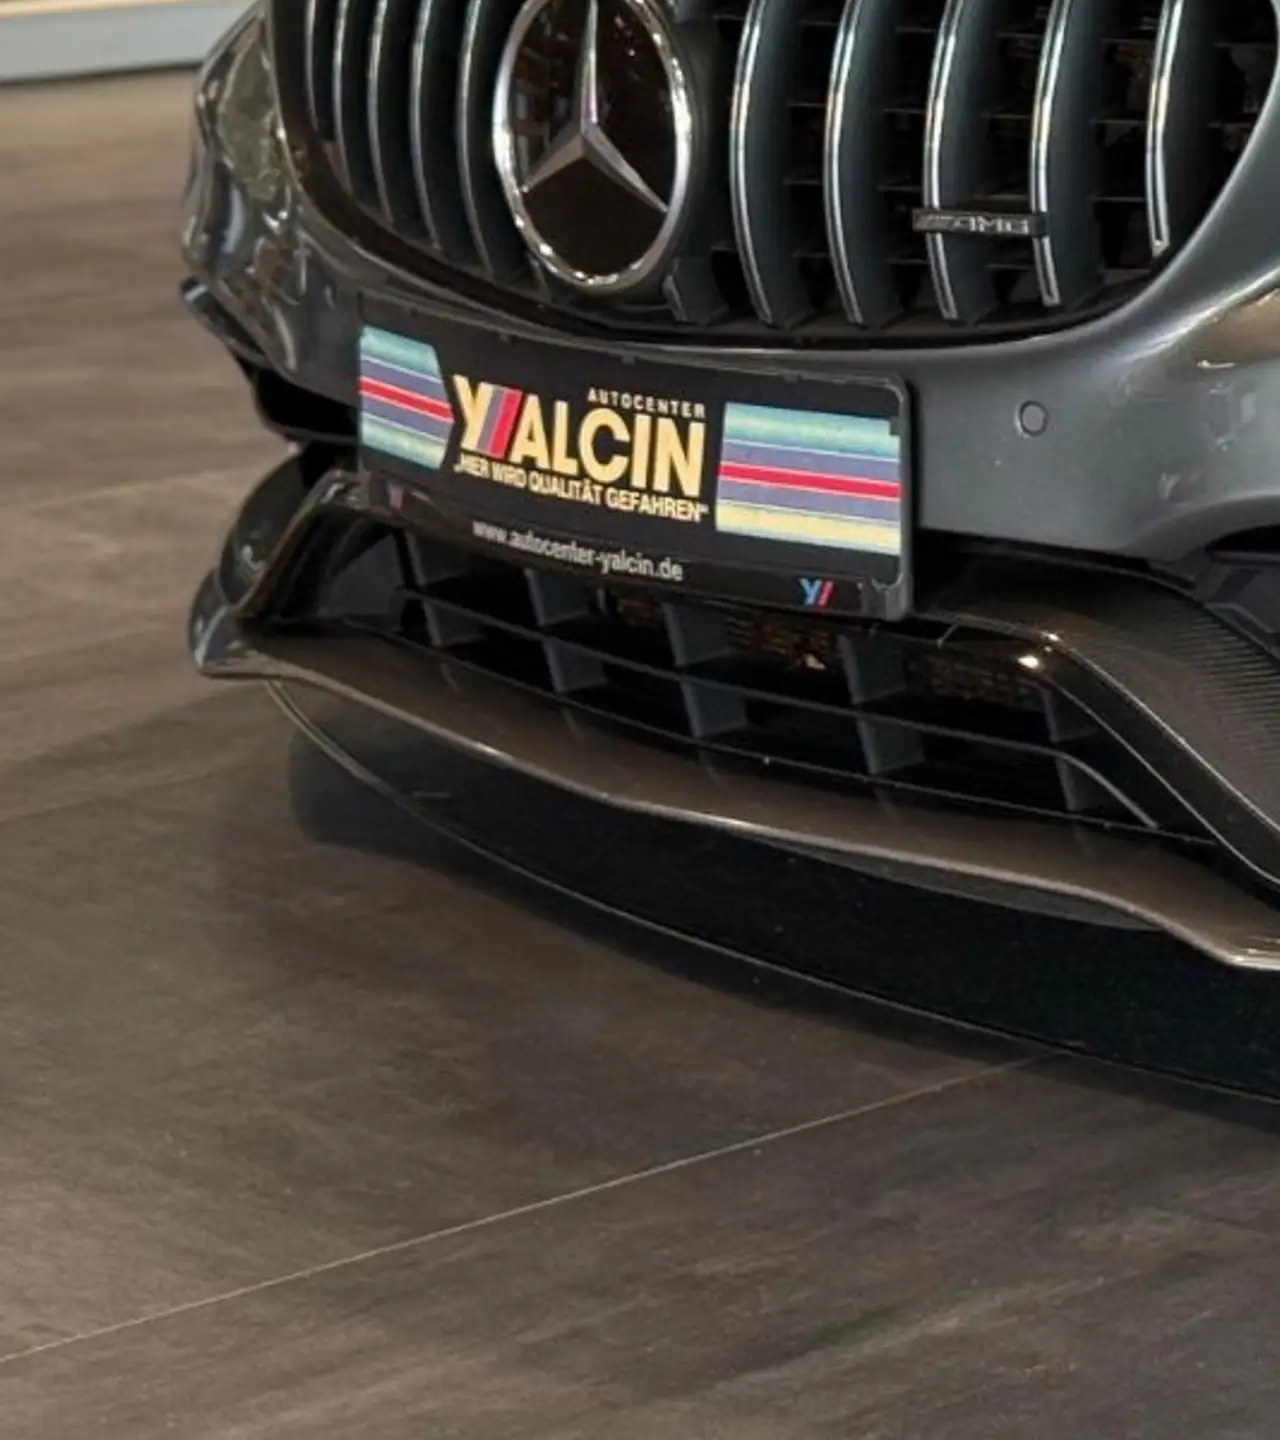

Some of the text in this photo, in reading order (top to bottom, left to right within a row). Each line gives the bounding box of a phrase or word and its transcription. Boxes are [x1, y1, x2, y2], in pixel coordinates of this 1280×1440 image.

[587, 386, 706, 419] AUTOCENTER
[528, 469, 604, 505] QUALITÄT
[472, 519, 683, 582] www.autocenter-yalcin.de
